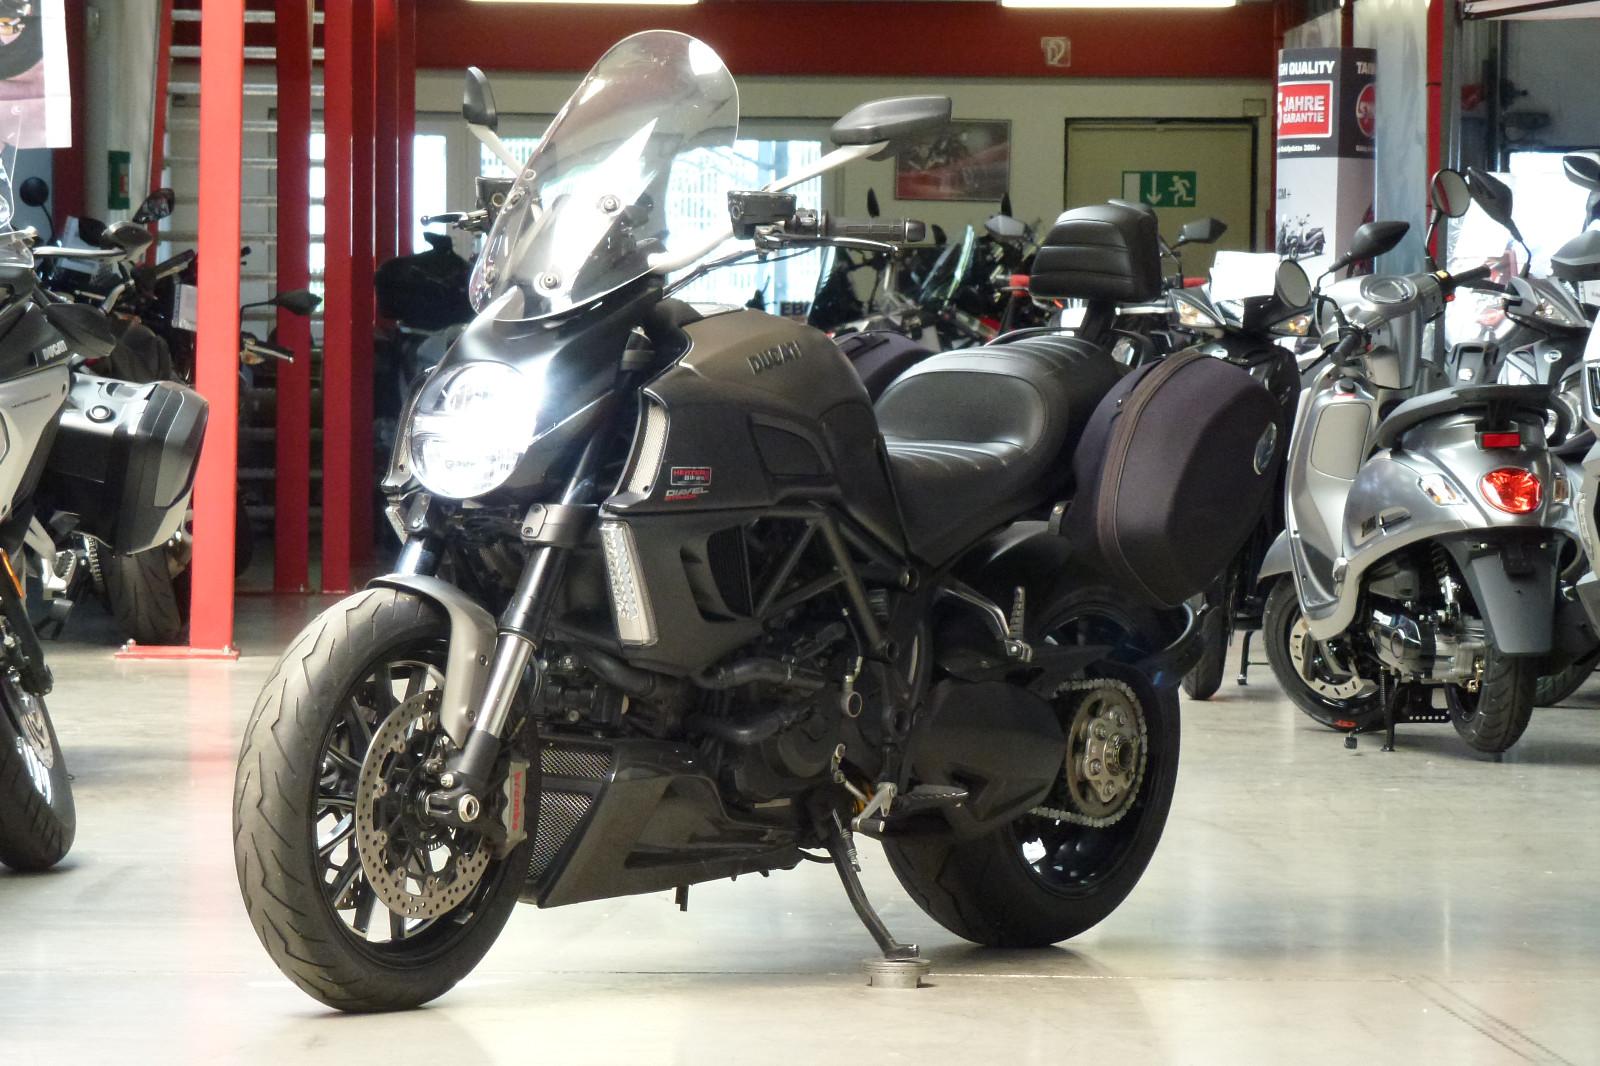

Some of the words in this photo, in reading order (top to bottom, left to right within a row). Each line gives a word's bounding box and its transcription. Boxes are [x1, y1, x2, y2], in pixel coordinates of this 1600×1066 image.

[1289, 60, 1335, 75] QUALITY
[1283, 95, 1325, 112] JAHRE
[1282, 111, 1325, 124] GARANTIE
[42, 339, 68, 361] DUCATI
[745, 340, 802, 376] DUCATI
